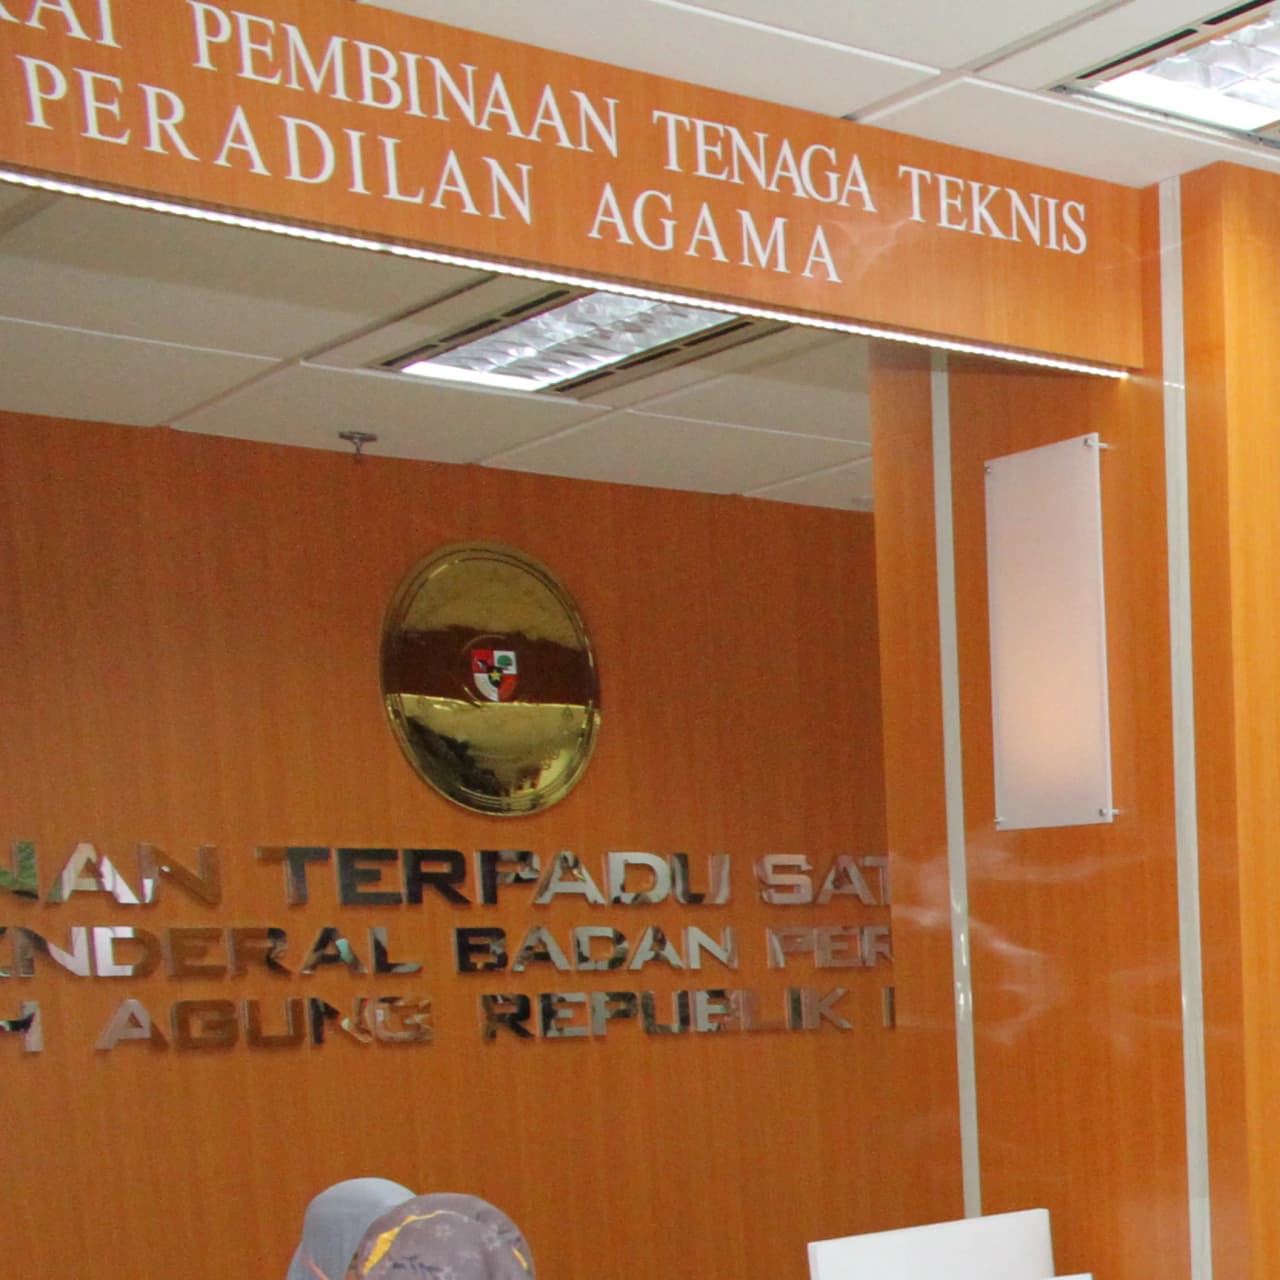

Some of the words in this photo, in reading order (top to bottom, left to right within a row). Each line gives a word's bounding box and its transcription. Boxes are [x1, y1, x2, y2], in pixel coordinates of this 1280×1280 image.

[188, 0, 619, 158] PEMBINAAN
[653, 110, 877, 213] TENAGA
[899, 165, 1088, 255] TEKNIS
[16, 54, 533, 225] PERADILAN
[589, 183, 843, 284] AGAMA
[257, 847, 731, 906] TERPADU
[0, 924, 424, 981] NDERAL
[455, 924, 739, 975] BADAN
[95, 996, 434, 1053] AGUNG
[479, 984, 855, 1044] REPUBLIK
